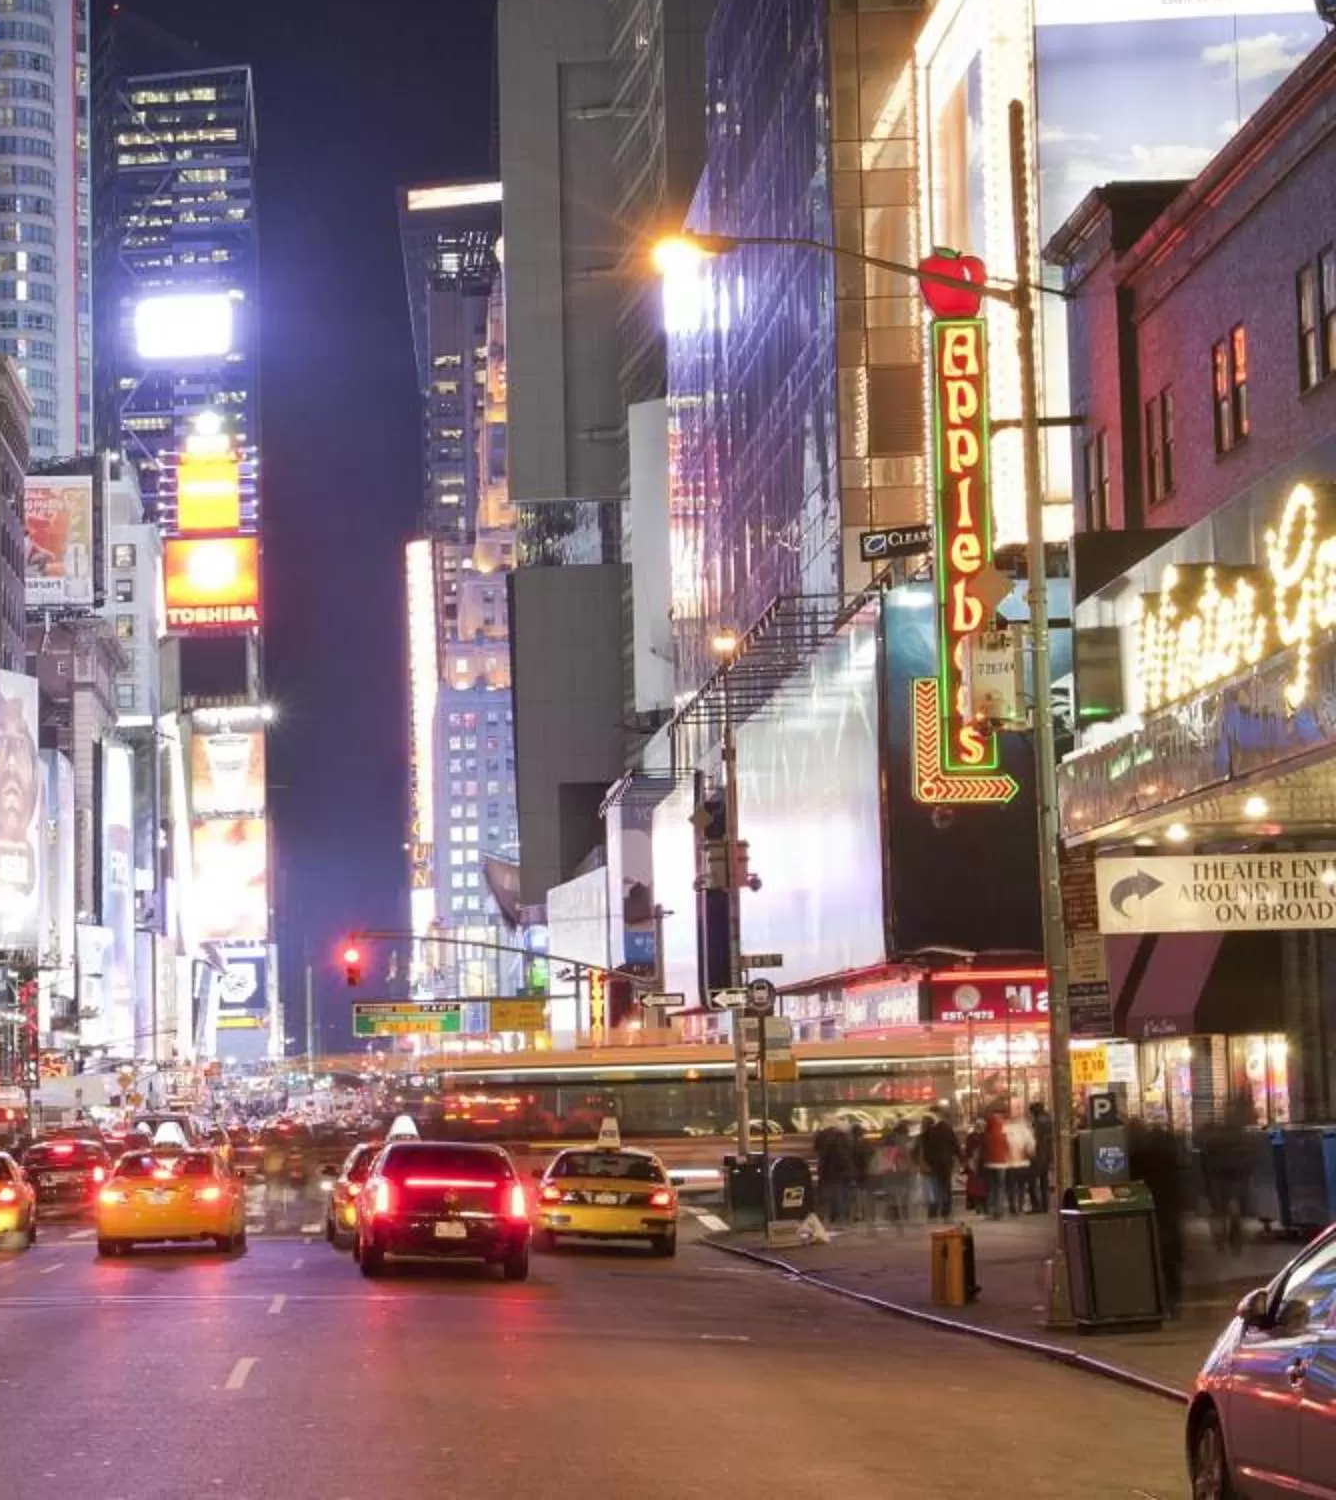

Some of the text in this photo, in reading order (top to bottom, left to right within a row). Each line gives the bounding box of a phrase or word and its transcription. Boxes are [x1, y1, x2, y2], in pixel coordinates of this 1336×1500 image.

[167, 605, 258, 625] TOSHIBA
[1192, 860, 1283, 882] THEATER
[1178, 881, 1270, 902] AROUND
[1278, 880, 1321, 900] THE
[1215, 901, 1336, 923] ON BROAD
[1093, 1102, 1111, 1119] P
